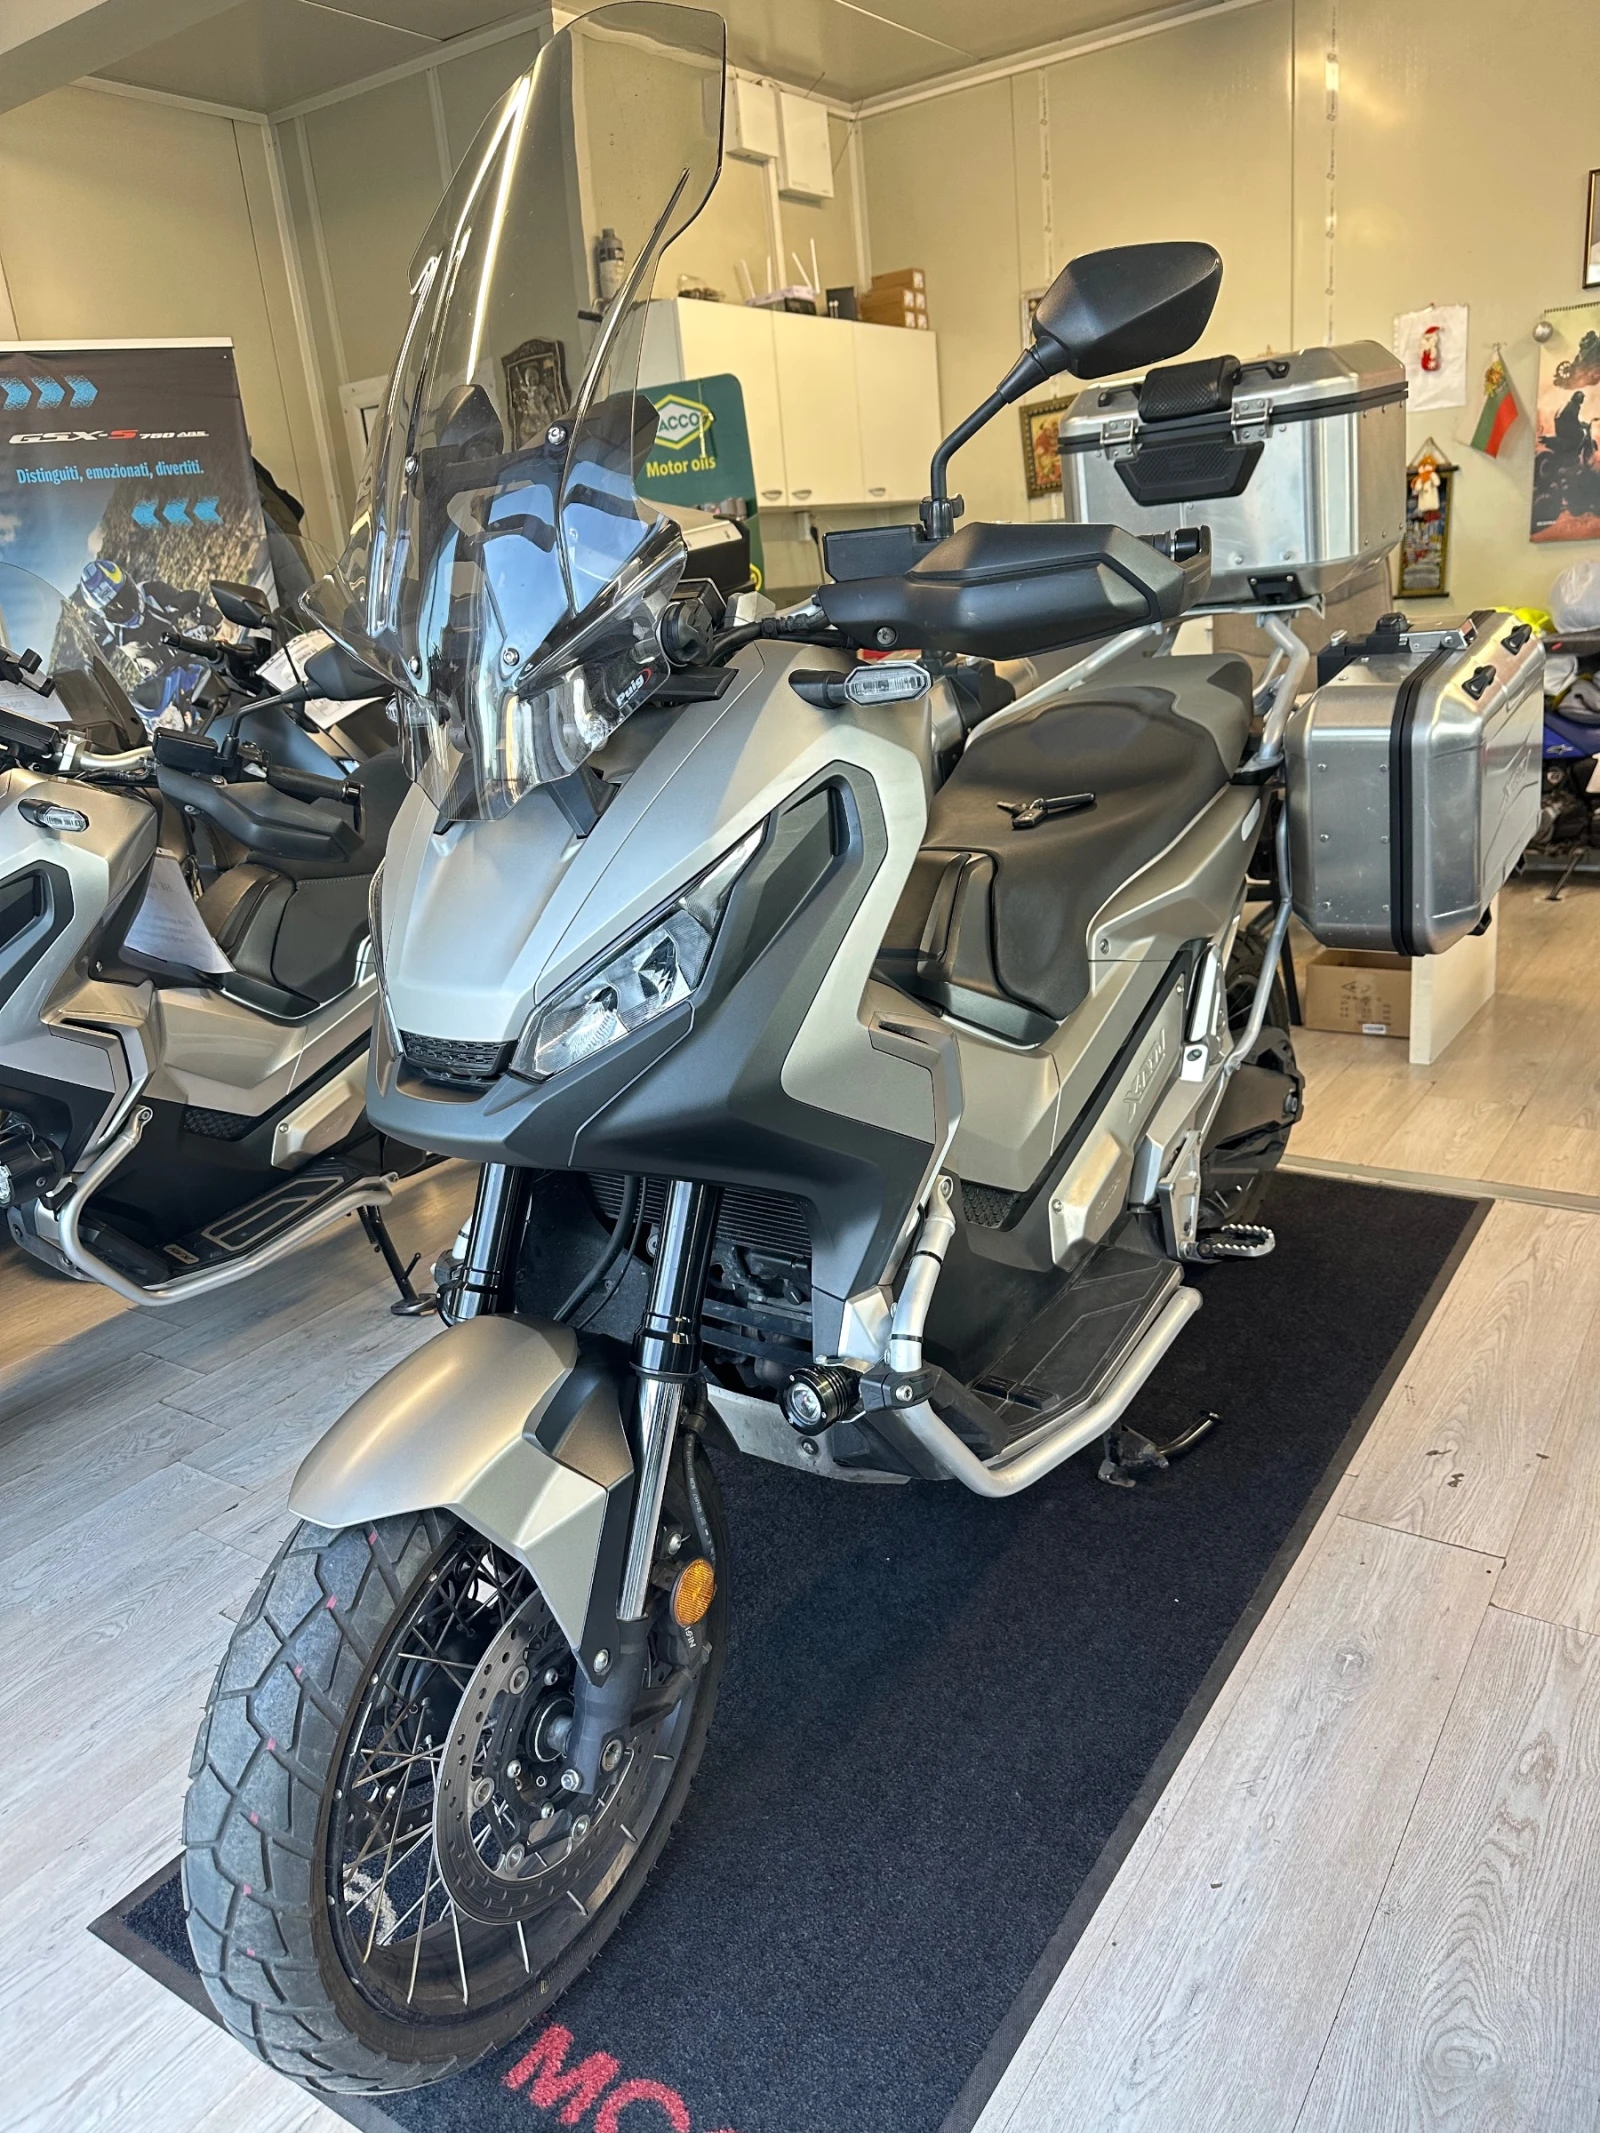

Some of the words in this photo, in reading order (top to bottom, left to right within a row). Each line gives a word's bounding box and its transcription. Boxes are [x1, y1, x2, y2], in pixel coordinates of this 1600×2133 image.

[659, 412, 698, 432] ACCO
[8, 429, 138, 445] GSX-S
[140, 431, 176, 441] 750
[16, 465, 83, 485] Distinguiti,
[86, 462, 153, 480] emozionati,
[156, 459, 205, 477] divertiti.
[646, 459, 689, 478] Motor
[691, 456, 717, 471] oils
[616, 674, 645, 707] Puig
[502, 2024, 735, 2133] MO
